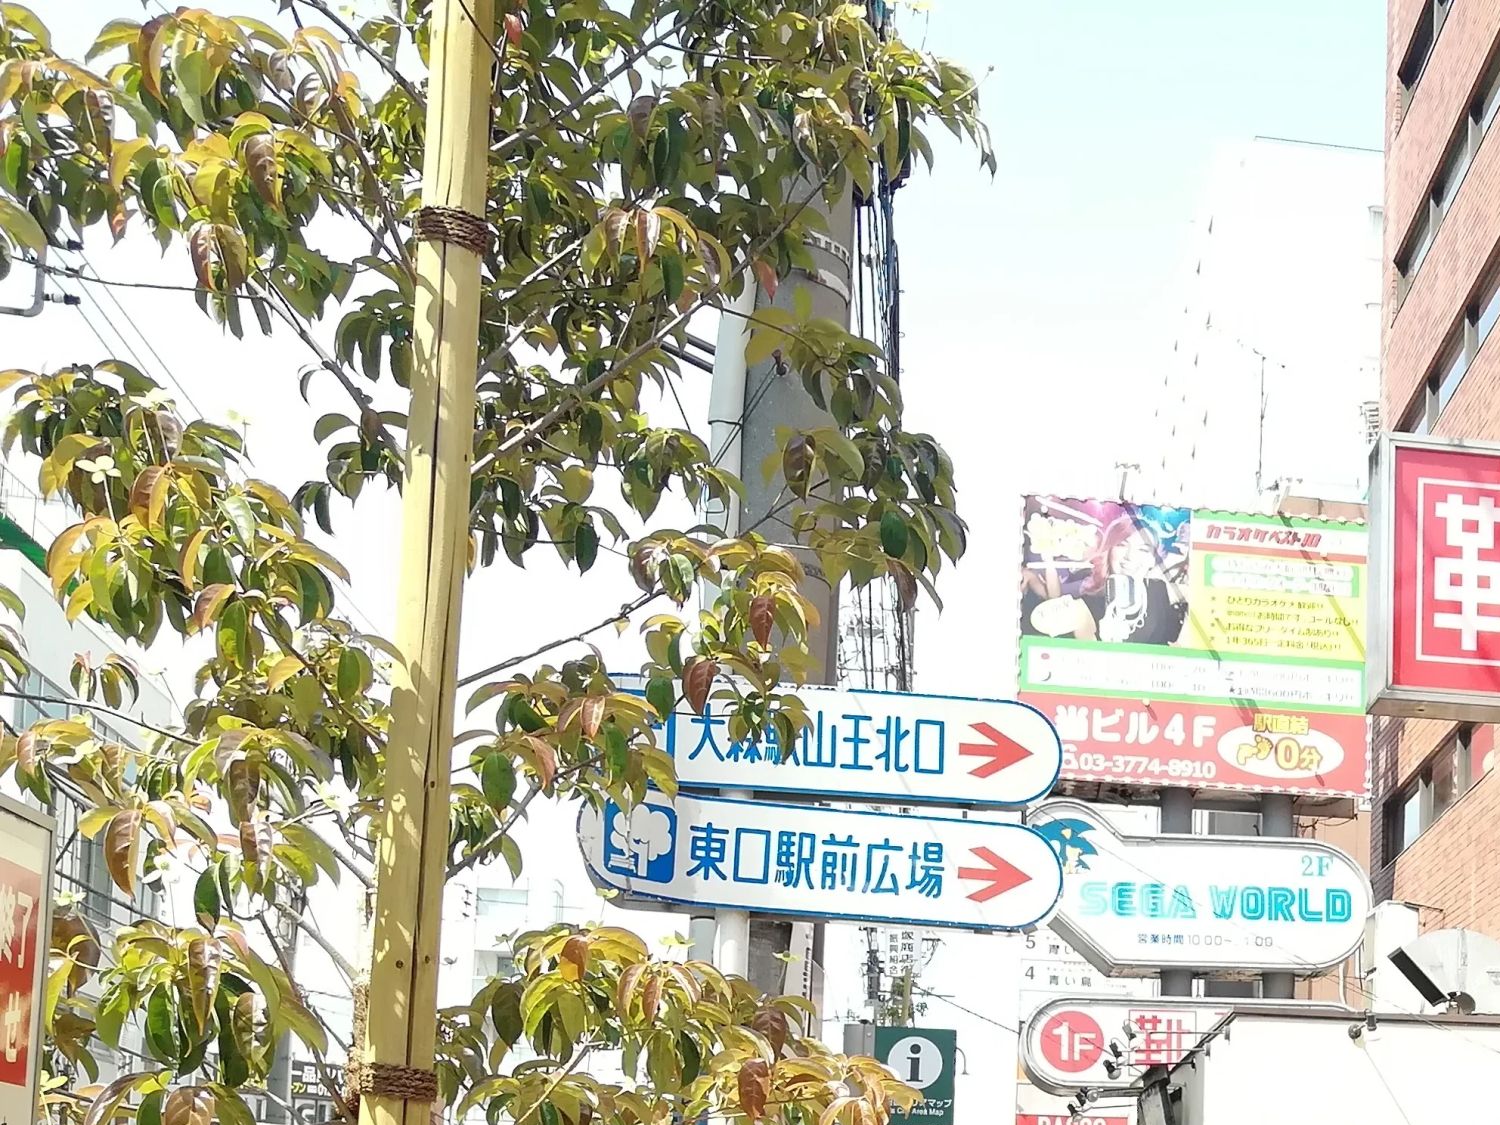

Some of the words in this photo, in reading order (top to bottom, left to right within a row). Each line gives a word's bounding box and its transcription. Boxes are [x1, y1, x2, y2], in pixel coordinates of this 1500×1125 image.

[1055, 704, 1217, 749] 当ビル4F
[1253, 712, 1310, 736] 駅直結
[1079, 752, 1217, 779] 03-3774-8910
[1274, 736, 1324, 772] 0分
[687, 822, 945, 899] 東口駅前広場
[1301, 854, 1334, 878] 2F
[1079, 881, 1196, 919] SEGA
[1208, 885, 1352, 922] WORLD
[1025, 934, 1036, 950] 5
[1024, 965, 1035, 980] 4
[1051, 1020, 1097, 1062] 1F
